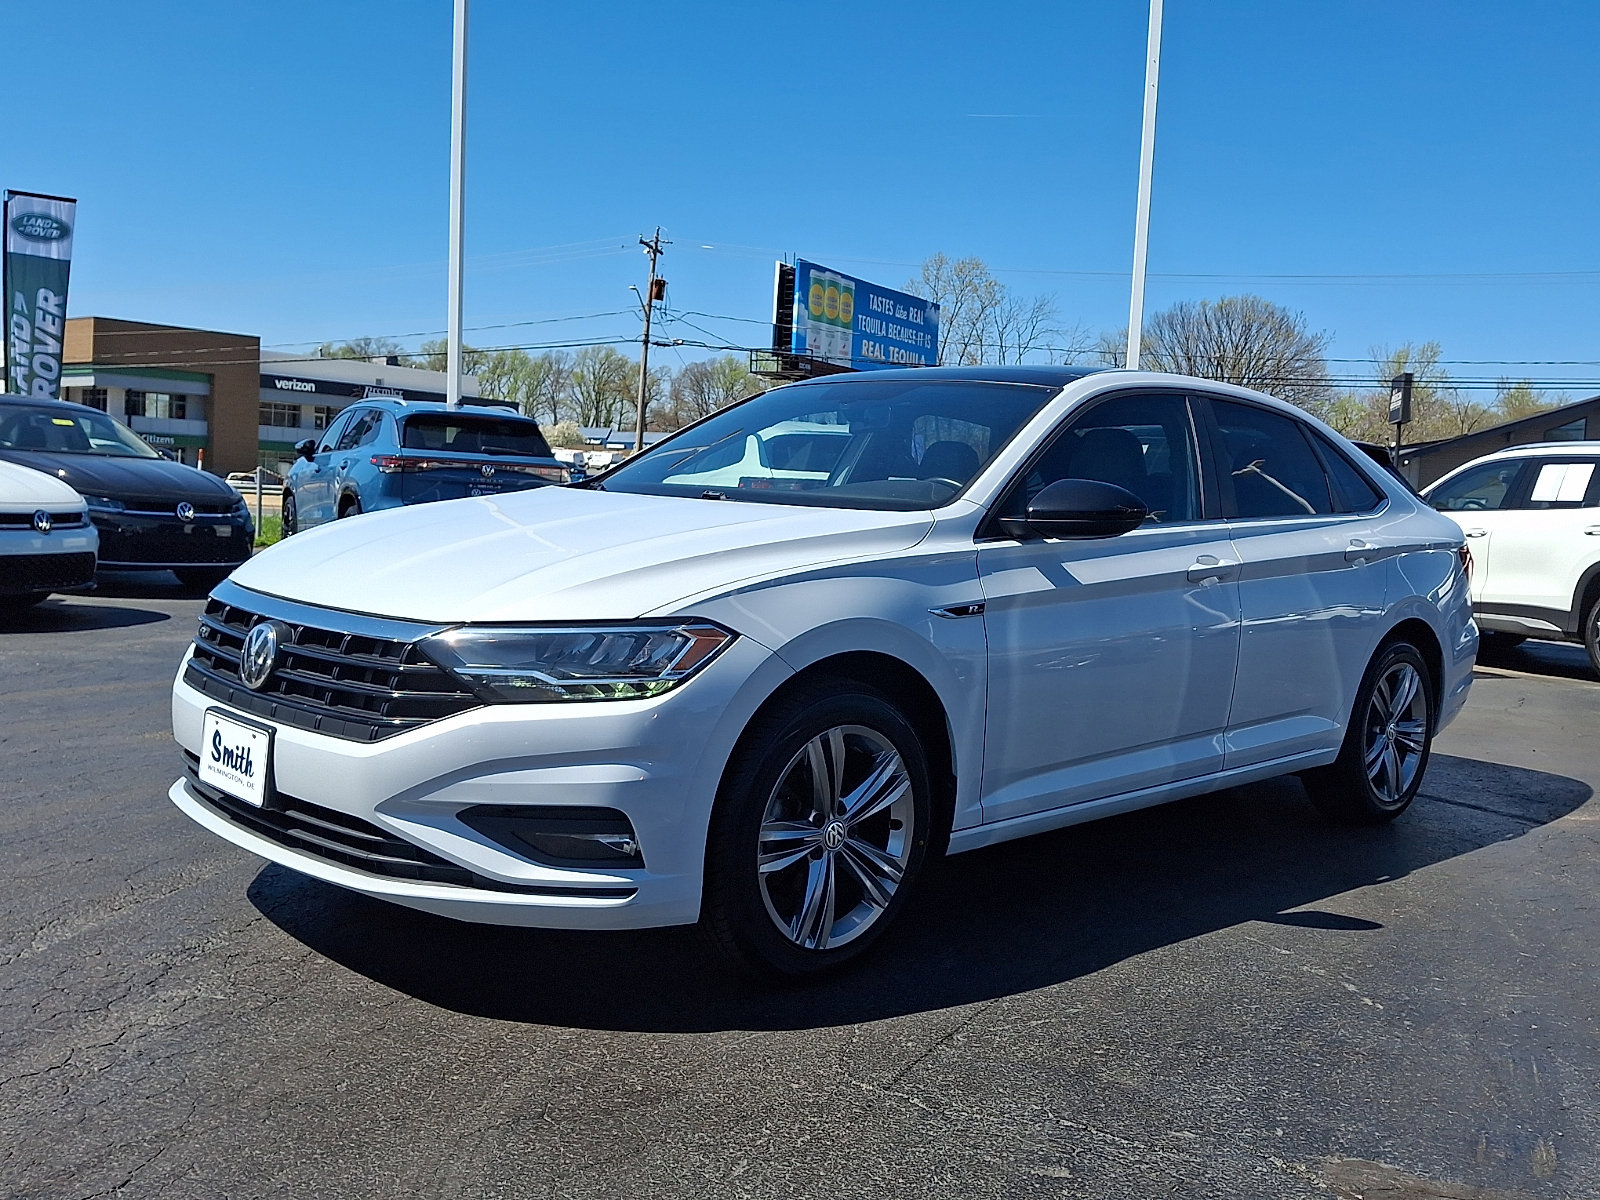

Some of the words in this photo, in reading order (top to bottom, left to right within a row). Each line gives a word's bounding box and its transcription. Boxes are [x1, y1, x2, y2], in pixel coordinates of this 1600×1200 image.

[23, 216, 52, 228] LAND
[25, 225, 61, 238] ROVER
[869, 294, 894, 316] TASTES
[908, 306, 924, 325] REAL
[858, 314, 887, 337] TEQUILA
[888, 322, 916, 345] BECAUSE
[917, 331, 924, 347] IT
[924, 333, 932, 349] IS
[32, 287, 64, 399] ROVER
[862, 339, 886, 360] REAL
[274, 379, 316, 393] verizon
[211, 729, 255, 778] Smith
[246, 781, 256, 791] DE
